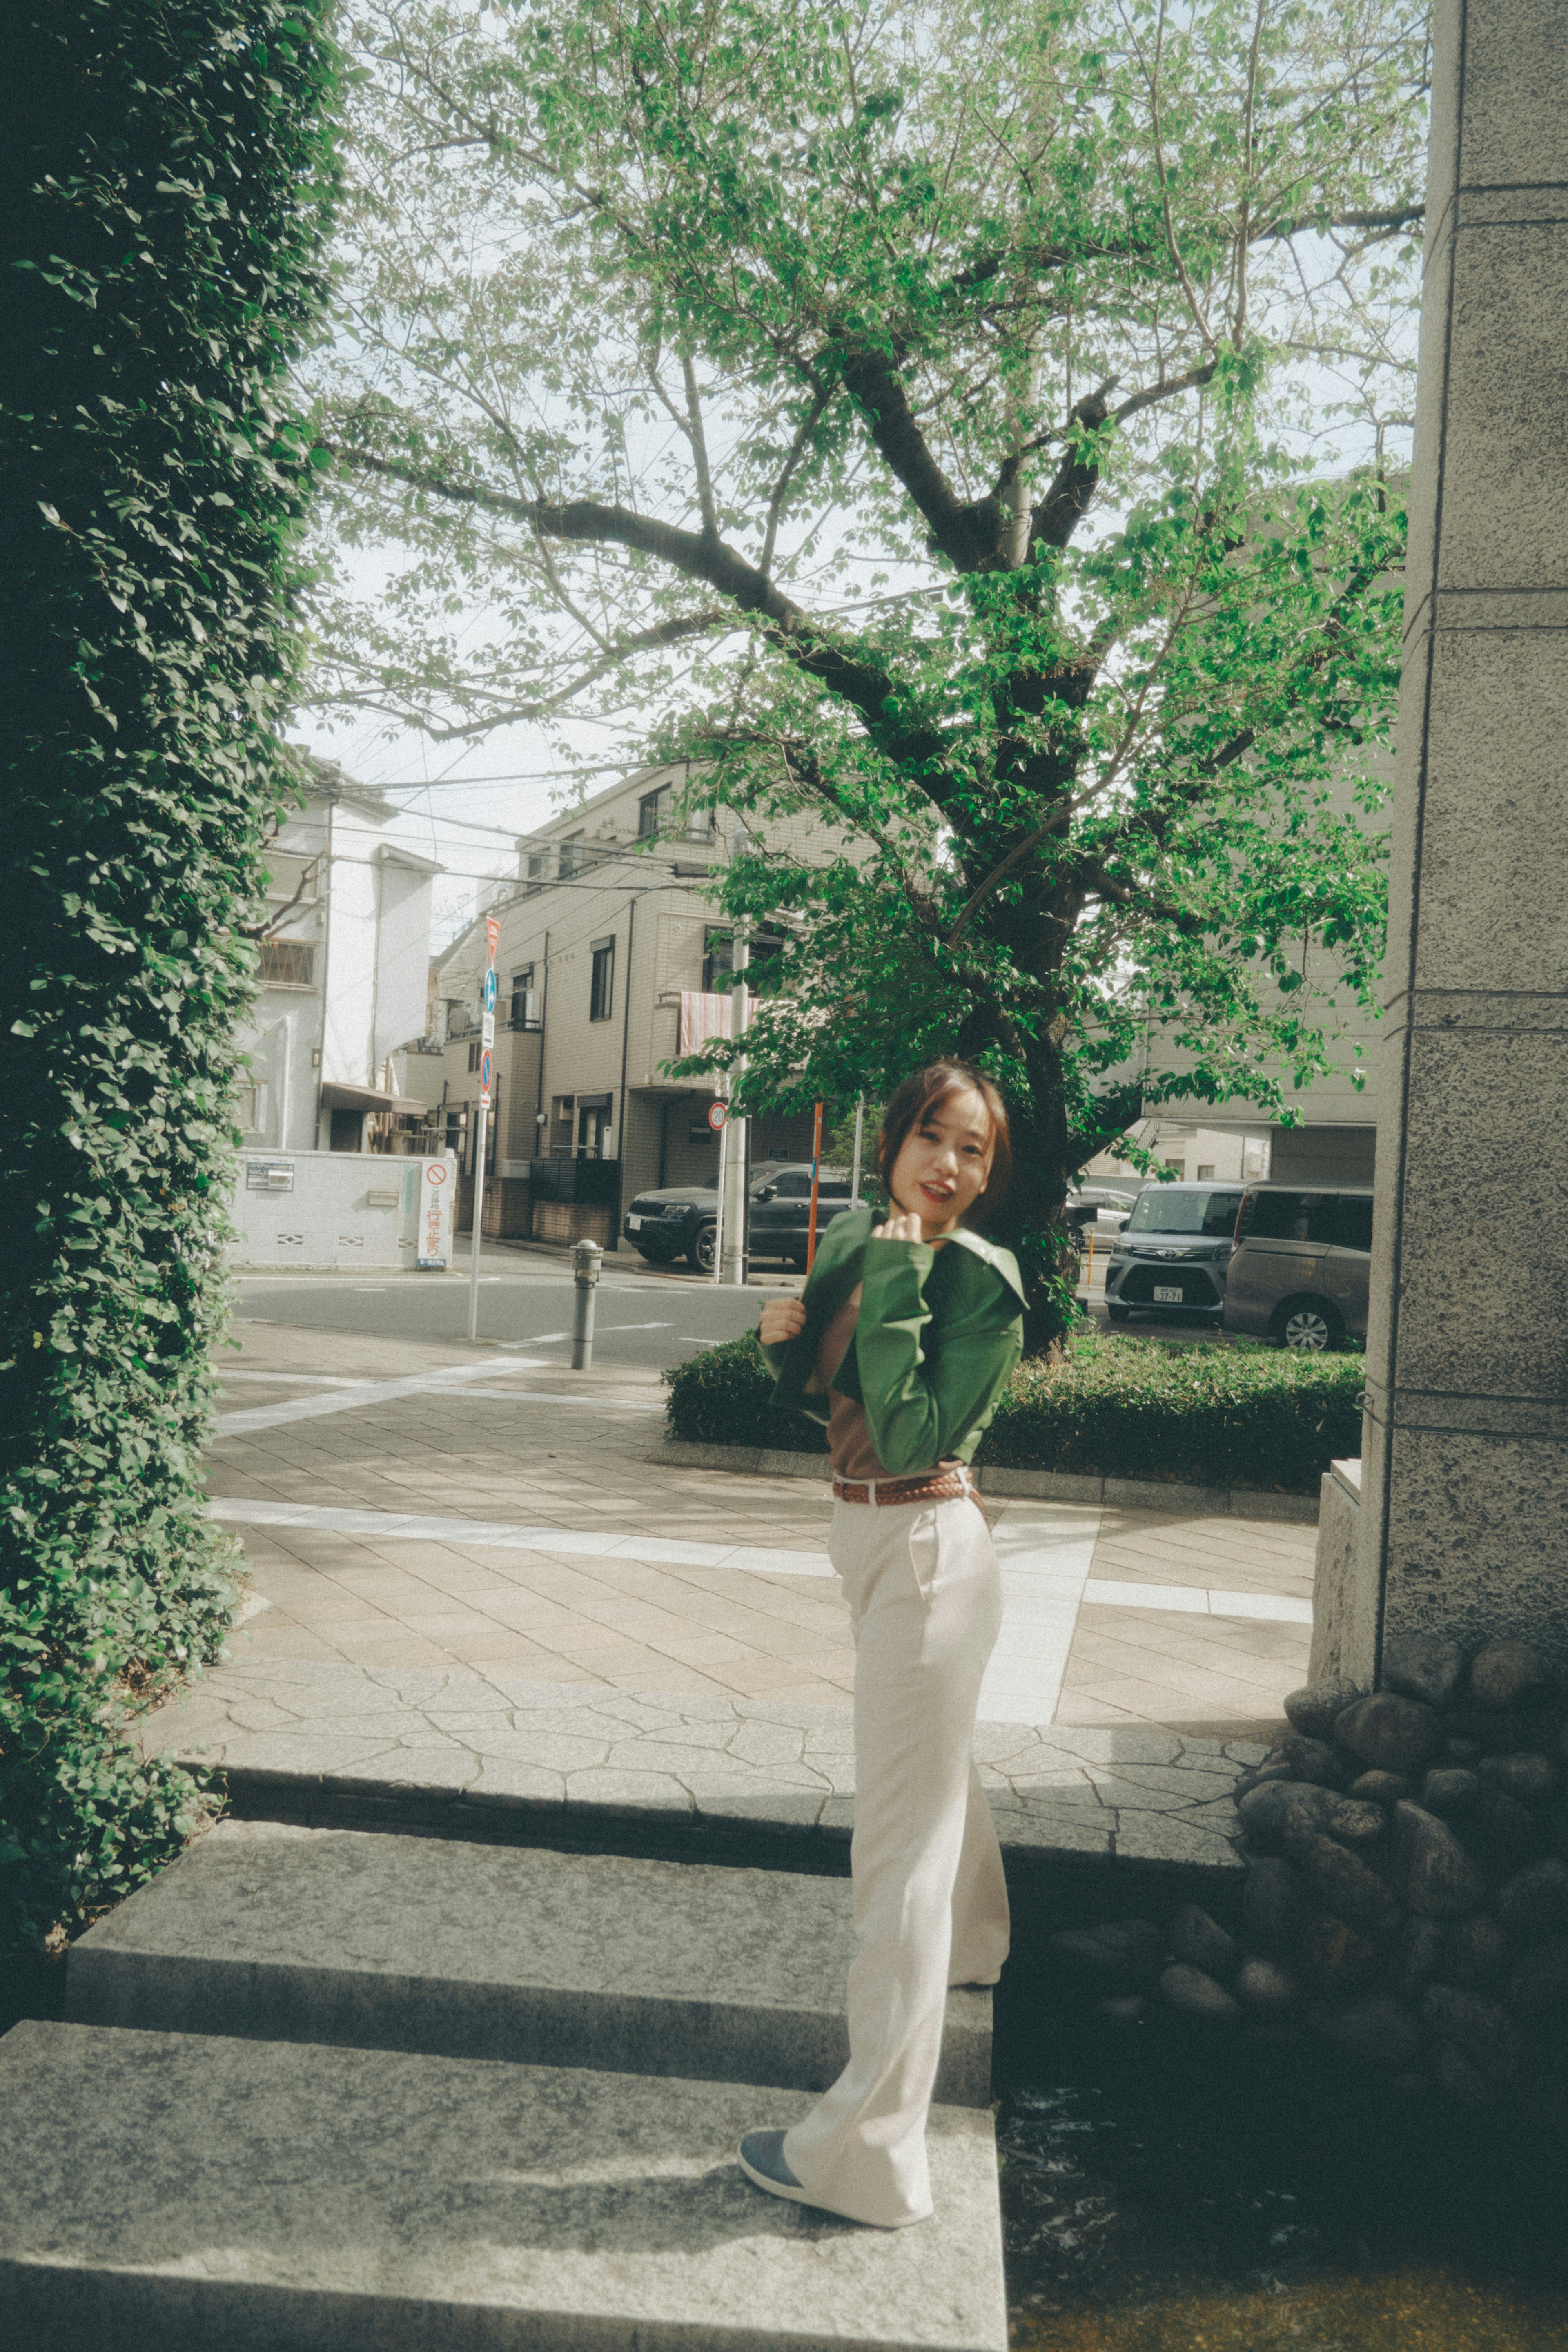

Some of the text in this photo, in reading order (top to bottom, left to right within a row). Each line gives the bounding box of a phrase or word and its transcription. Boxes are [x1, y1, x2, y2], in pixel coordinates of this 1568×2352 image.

[713, 1110, 724, 1122] 20
[426, 1210, 442, 1257] 行き止まり
